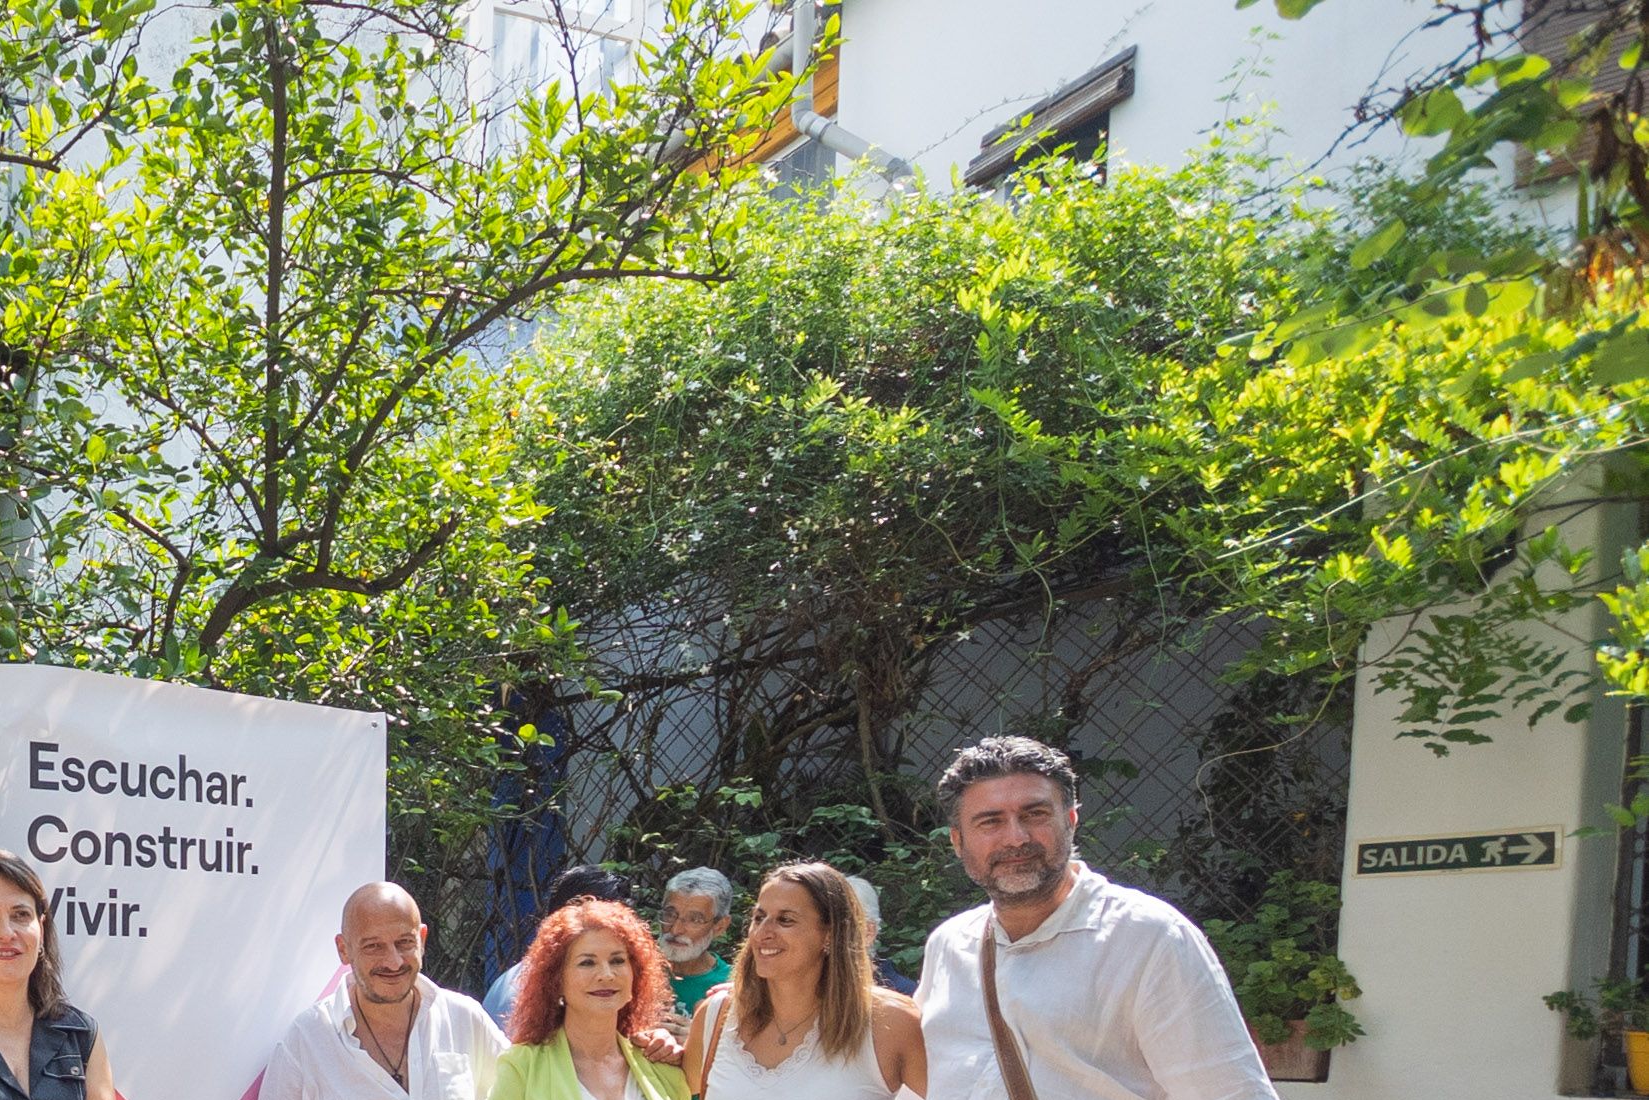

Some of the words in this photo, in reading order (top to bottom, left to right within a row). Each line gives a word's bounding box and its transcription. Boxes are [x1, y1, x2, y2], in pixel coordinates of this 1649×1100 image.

[28, 741, 254, 808] Escuchar.
[26, 815, 259, 875] Construir.
[1361, 843, 1469, 869] SALIDA
